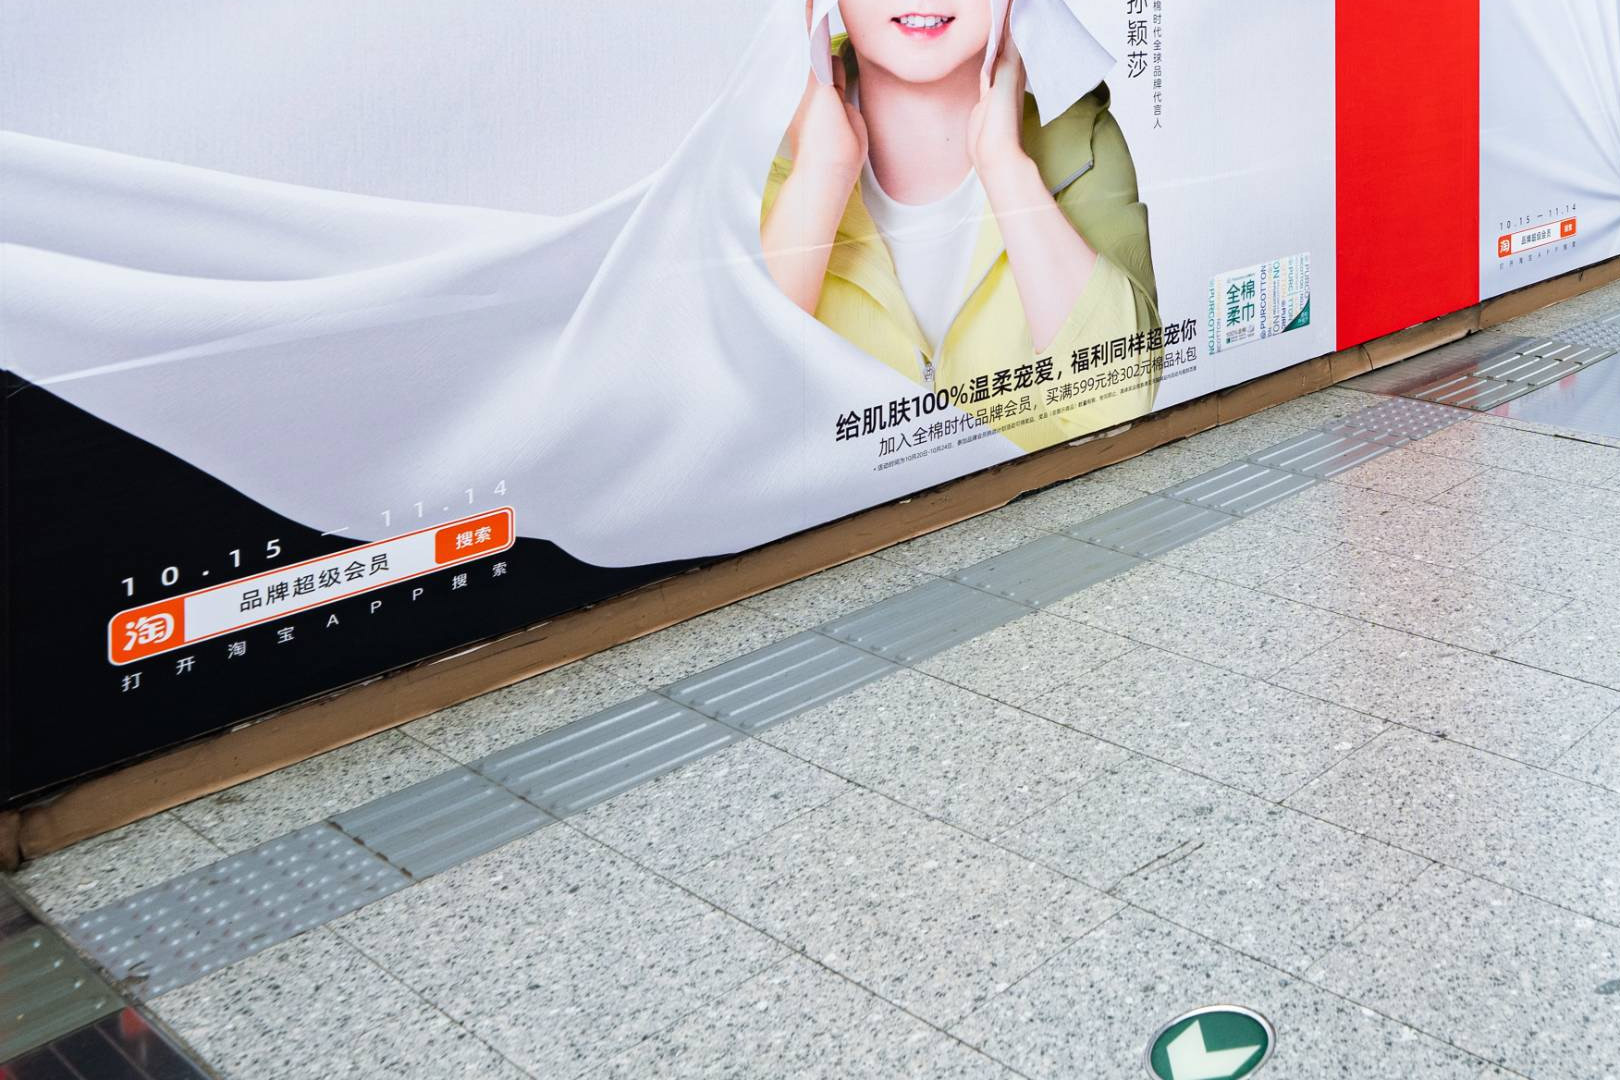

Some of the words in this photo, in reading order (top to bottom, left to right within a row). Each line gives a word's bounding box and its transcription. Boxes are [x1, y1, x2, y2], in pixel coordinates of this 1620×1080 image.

[1226, 279, 1256, 306] 全棉
[1226, 301, 1255, 328] 柔巾
[834, 317, 1199, 444] 给肌肤100%温柔宠爱，福利同样超宠你
[121, 537, 283, 598] 10.15
[380, 479, 510, 528] 11.14
[454, 523, 494, 552] 搜索
[239, 552, 391, 614] 品牌超级会员
[123, 610, 177, 654] 淘
